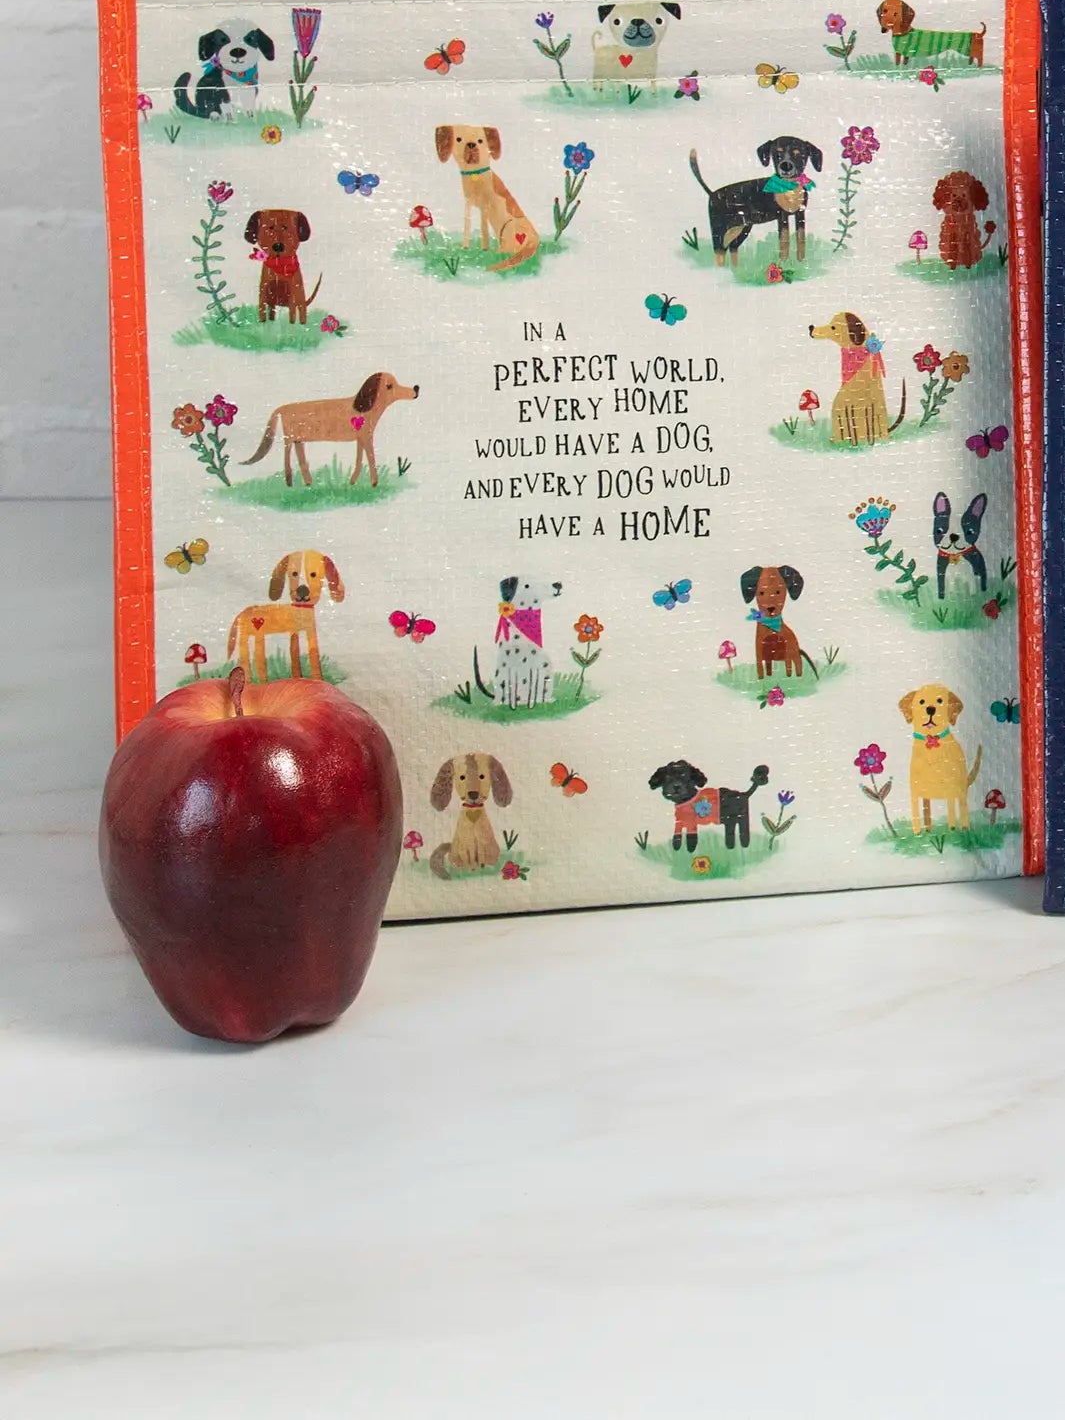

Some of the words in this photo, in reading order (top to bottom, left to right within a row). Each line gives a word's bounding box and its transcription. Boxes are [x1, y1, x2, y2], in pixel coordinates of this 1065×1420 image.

[523, 322, 542, 341] IN
[554, 322, 566, 341] A
[494, 354, 618, 390] PERFECT
[630, 356, 724, 383] WORLD,
[518, 396, 603, 422] EVERY
[614, 388, 688, 414] HOME
[475, 436, 546, 458] WOULD
[555, 433, 620, 456] HAVE
[631, 432, 645, 453] A
[656, 422, 713, 454] DOG,
[464, 478, 503, 499] AND
[510, 472, 587, 498] EVERY
[598, 466, 653, 498] DOG
[662, 464, 730, 488] WOULD
[519, 514, 581, 539] HAVE
[593, 517, 605, 536] A
[620, 505, 710, 540] HOME
